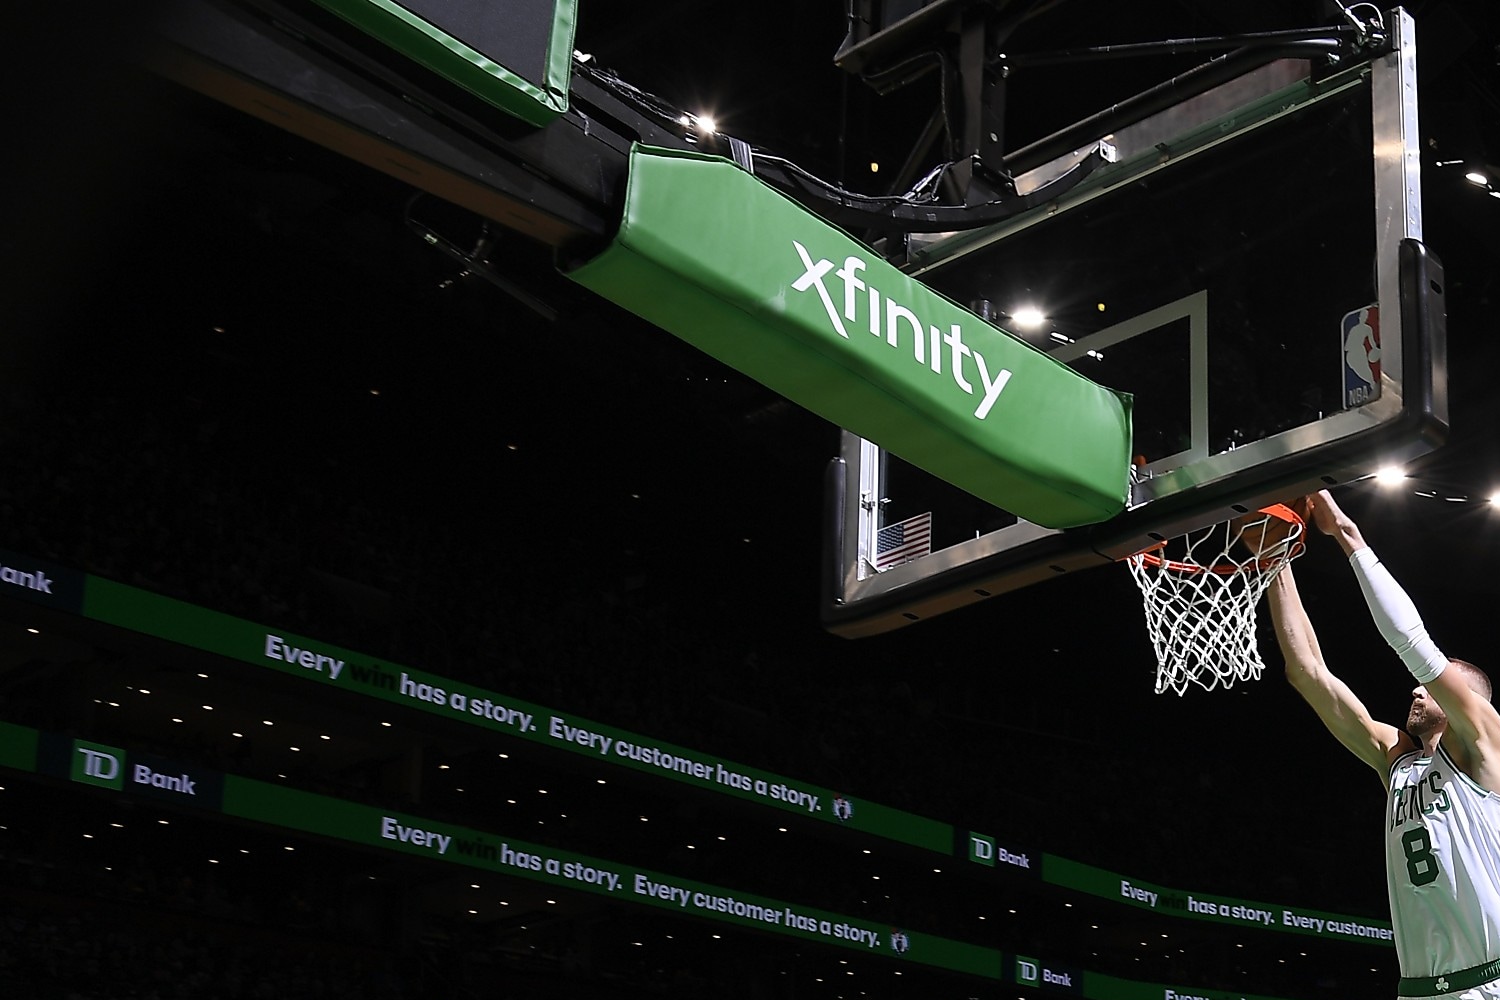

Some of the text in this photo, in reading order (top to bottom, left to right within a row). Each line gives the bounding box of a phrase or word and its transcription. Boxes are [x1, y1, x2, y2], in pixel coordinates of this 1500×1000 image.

[791, 240, 1012, 420] xfinity
[1349, 385, 1369, 406] NBA
[0, 565, 52, 594] ank
[265, 633, 821, 813] Every win has a story. Every customer has a story.
[77, 747, 196, 795] TD Bank
[971, 837, 1030, 869] TD Bank
[1401, 827, 1439, 887] 8
[381, 816, 880, 947] Every win has a story. Every customer has a story.
[1121, 880, 1394, 941] Every has a story. Every customer
[1018, 961, 1072, 988] TD Bank
